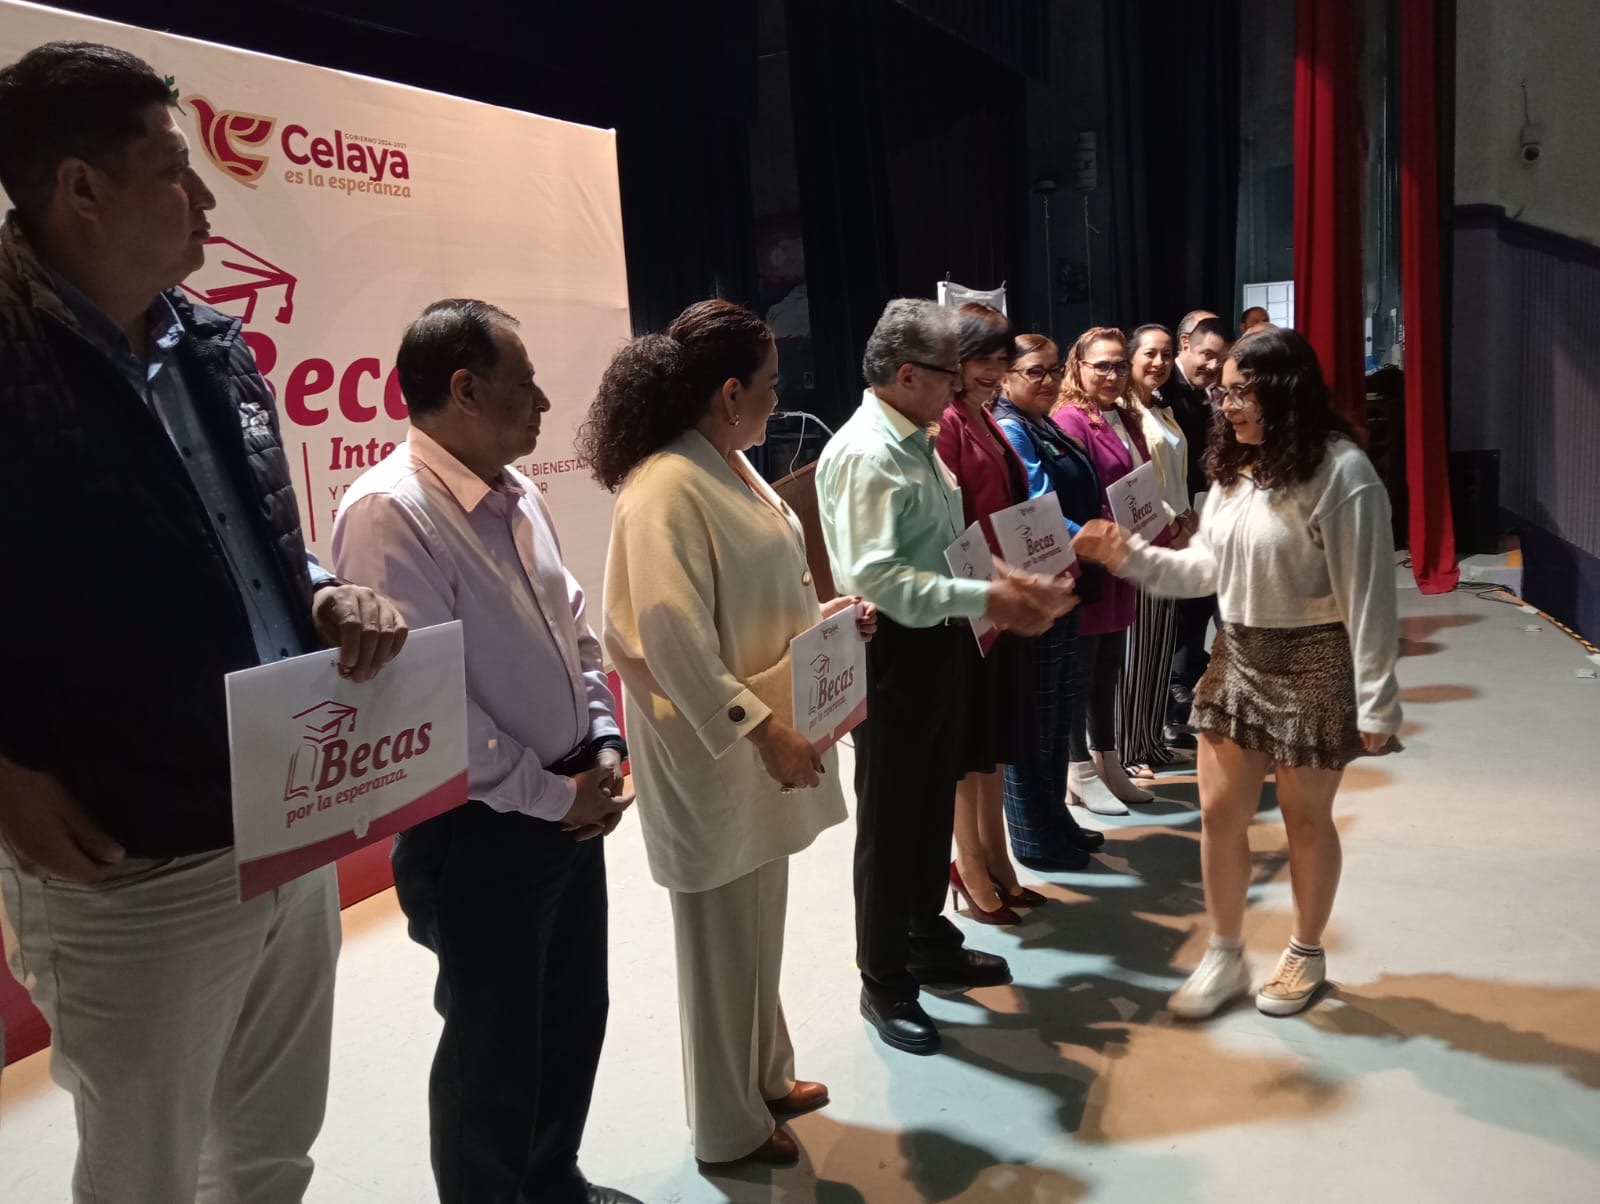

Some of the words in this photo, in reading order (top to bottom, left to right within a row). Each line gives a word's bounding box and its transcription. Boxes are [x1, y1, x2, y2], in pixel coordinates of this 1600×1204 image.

[281, 124, 410, 182] Celaya
[284, 170, 304, 185] es
[308, 168, 325, 188] la
[328, 176, 412, 199] esperanza
[328, 486, 338, 500] Y
[1026, 533, 1055, 556] Becas
[817, 665, 855, 710] Becas
[316, 721, 432, 792] Becas
[286, 804, 314, 829] por
[317, 794, 331, 811] la
[335, 768, 408, 804] esperanza.
